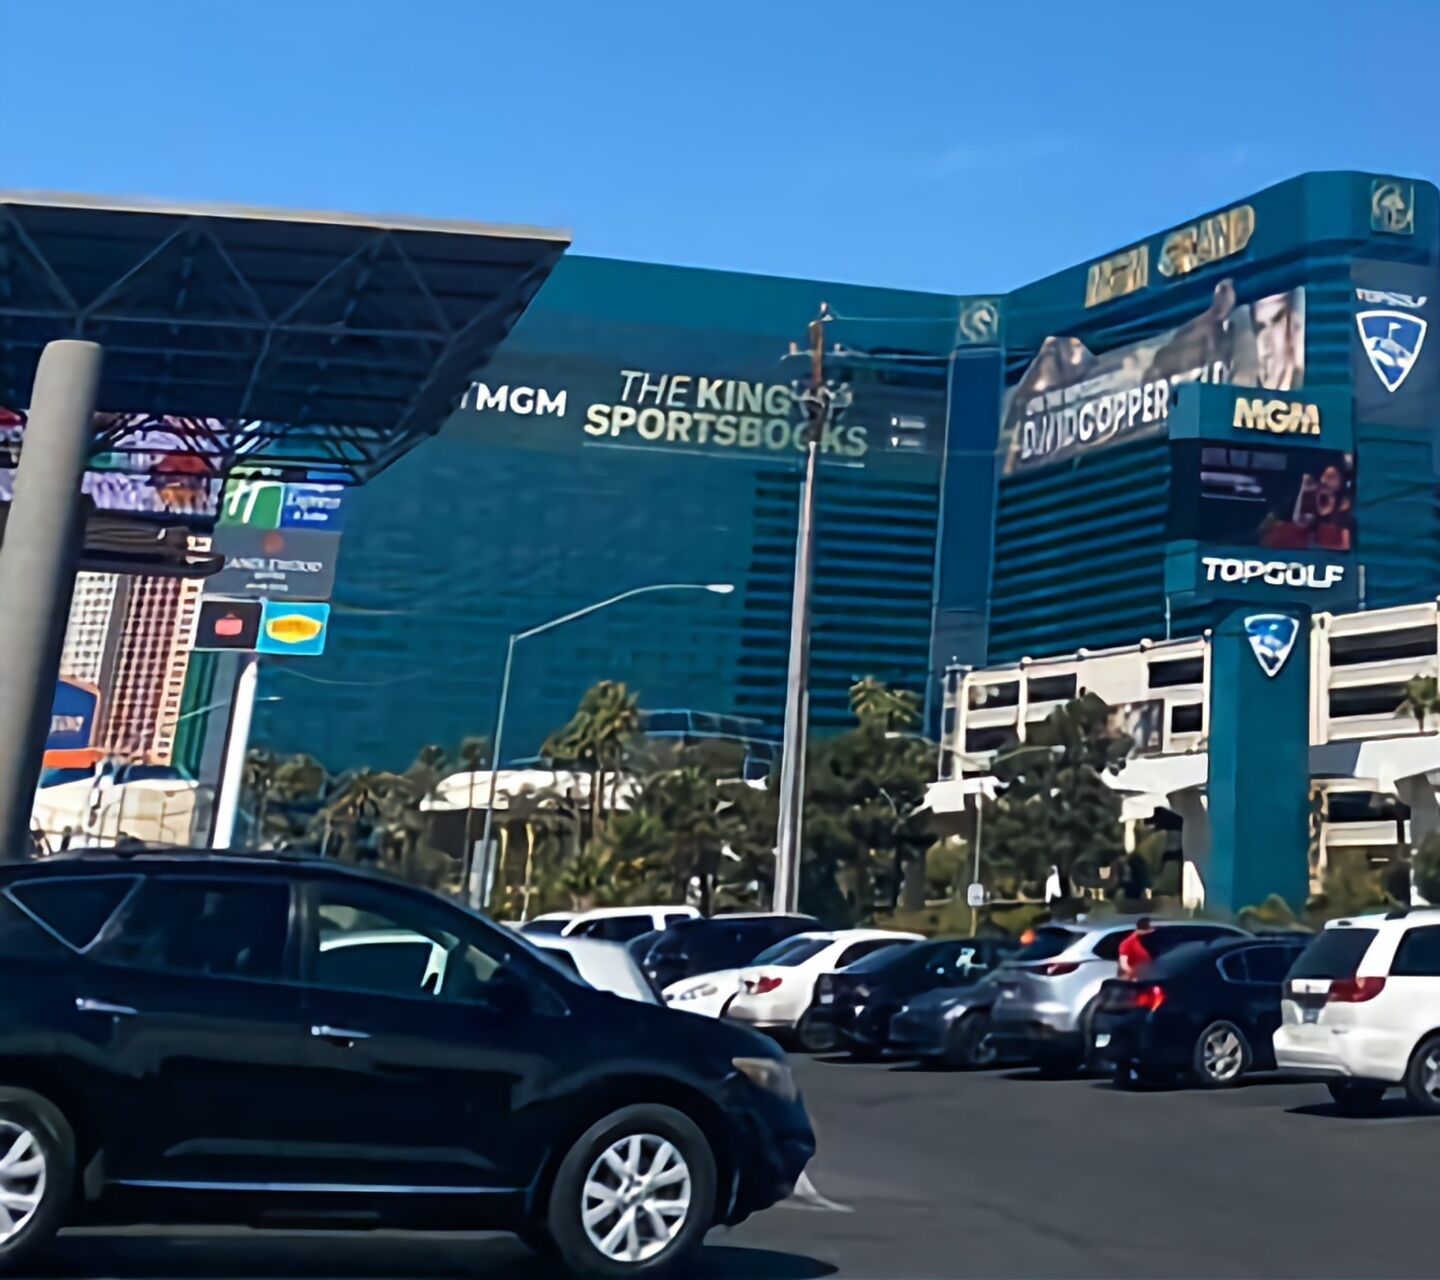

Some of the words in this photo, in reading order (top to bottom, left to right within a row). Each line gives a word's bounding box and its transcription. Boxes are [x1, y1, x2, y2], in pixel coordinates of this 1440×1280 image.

[618, 370, 691, 408] THE
[696, 376, 792, 416] KING
[1233, 397, 1321, 435] MGM
[1202, 556, 1345, 589] TOPGOLF
